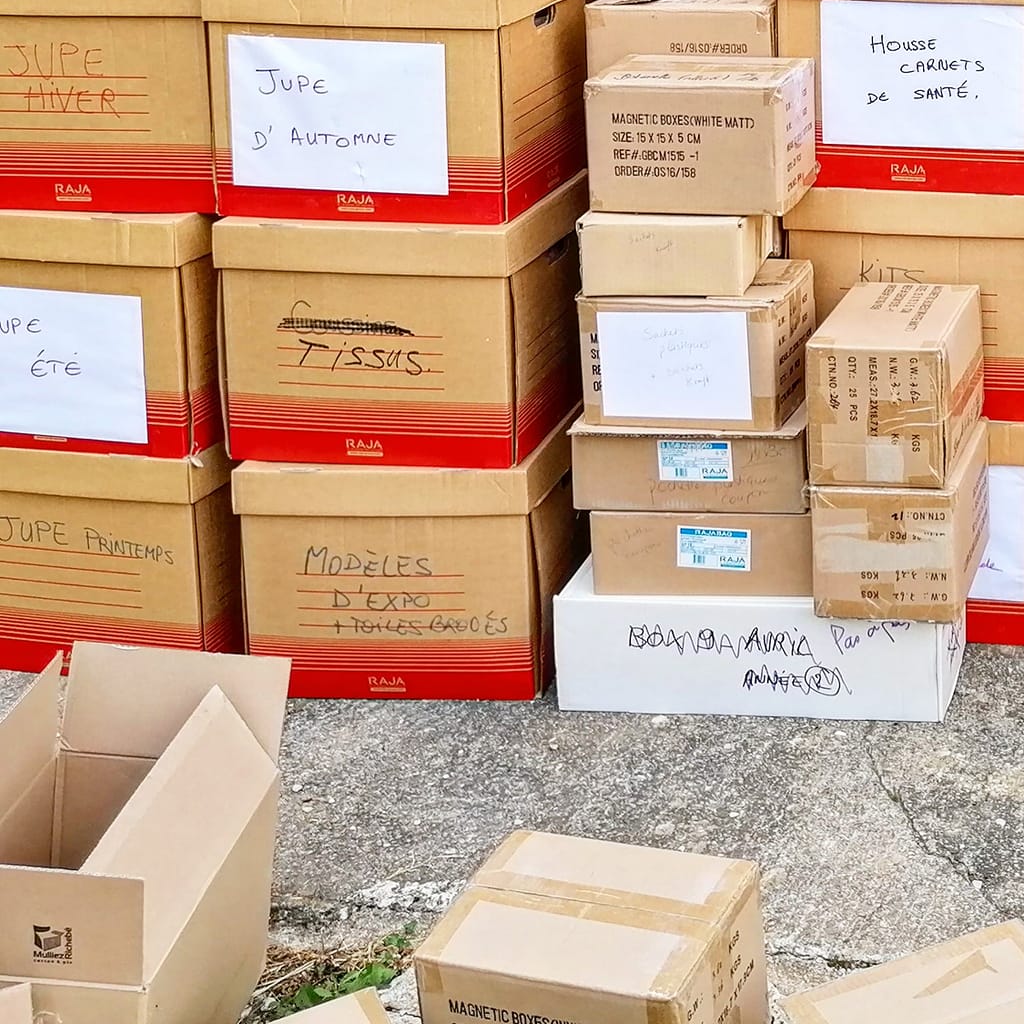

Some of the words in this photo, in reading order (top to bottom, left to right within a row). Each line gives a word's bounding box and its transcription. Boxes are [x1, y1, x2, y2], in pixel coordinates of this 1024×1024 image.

[3, 42, 104, 80] JUPE
[899, 58, 985, 74] CARNETS
[866, 91, 889, 105] DE
[611, 113, 659, 126] MAGNETIC
[660, 115, 723, 128] BOXES(WHITE
[724, 117, 755, 129] MATT)
[290, 127, 398, 148] AUTOMNE
[612, 132, 635, 143] SIZE:
[636, 132, 646, 143] 15
[648, 132, 654, 143] X
[656, 133, 666, 143] 15
[668, 133, 674, 143] X
[677, 132, 684, 144] 5
[686, 133, 701, 144] CM
[890, 163, 926, 174] RAJA
[54, 183, 92, 195] RAJA
[336, 193, 375, 205] RAJA
[0, 317, 42, 335] UPE
[30, 349, 82, 378] ÉTÉ
[848, 387, 858, 399] 25
[849, 404, 859, 422] PCS
[345, 438, 383, 450] RAJA
[911, 434, 921, 453] KGS
[701, 467, 728, 475] RAJA
[0, 515, 69, 546] JUPE
[889, 530, 907, 541] PCS
[304, 544, 433, 577] MODÈLES
[719, 555, 746, 564] RAJA
[860, 571, 879, 580] KGS
[331, 583, 431, 612] D'EXPO
[860, 590, 879, 599] KGS
[333, 619, 344, 635] +
[367, 676, 406, 686] RAJA
[33, 950, 65, 960] Mulliez
[448, 998, 510, 1024] MAGNETIC
